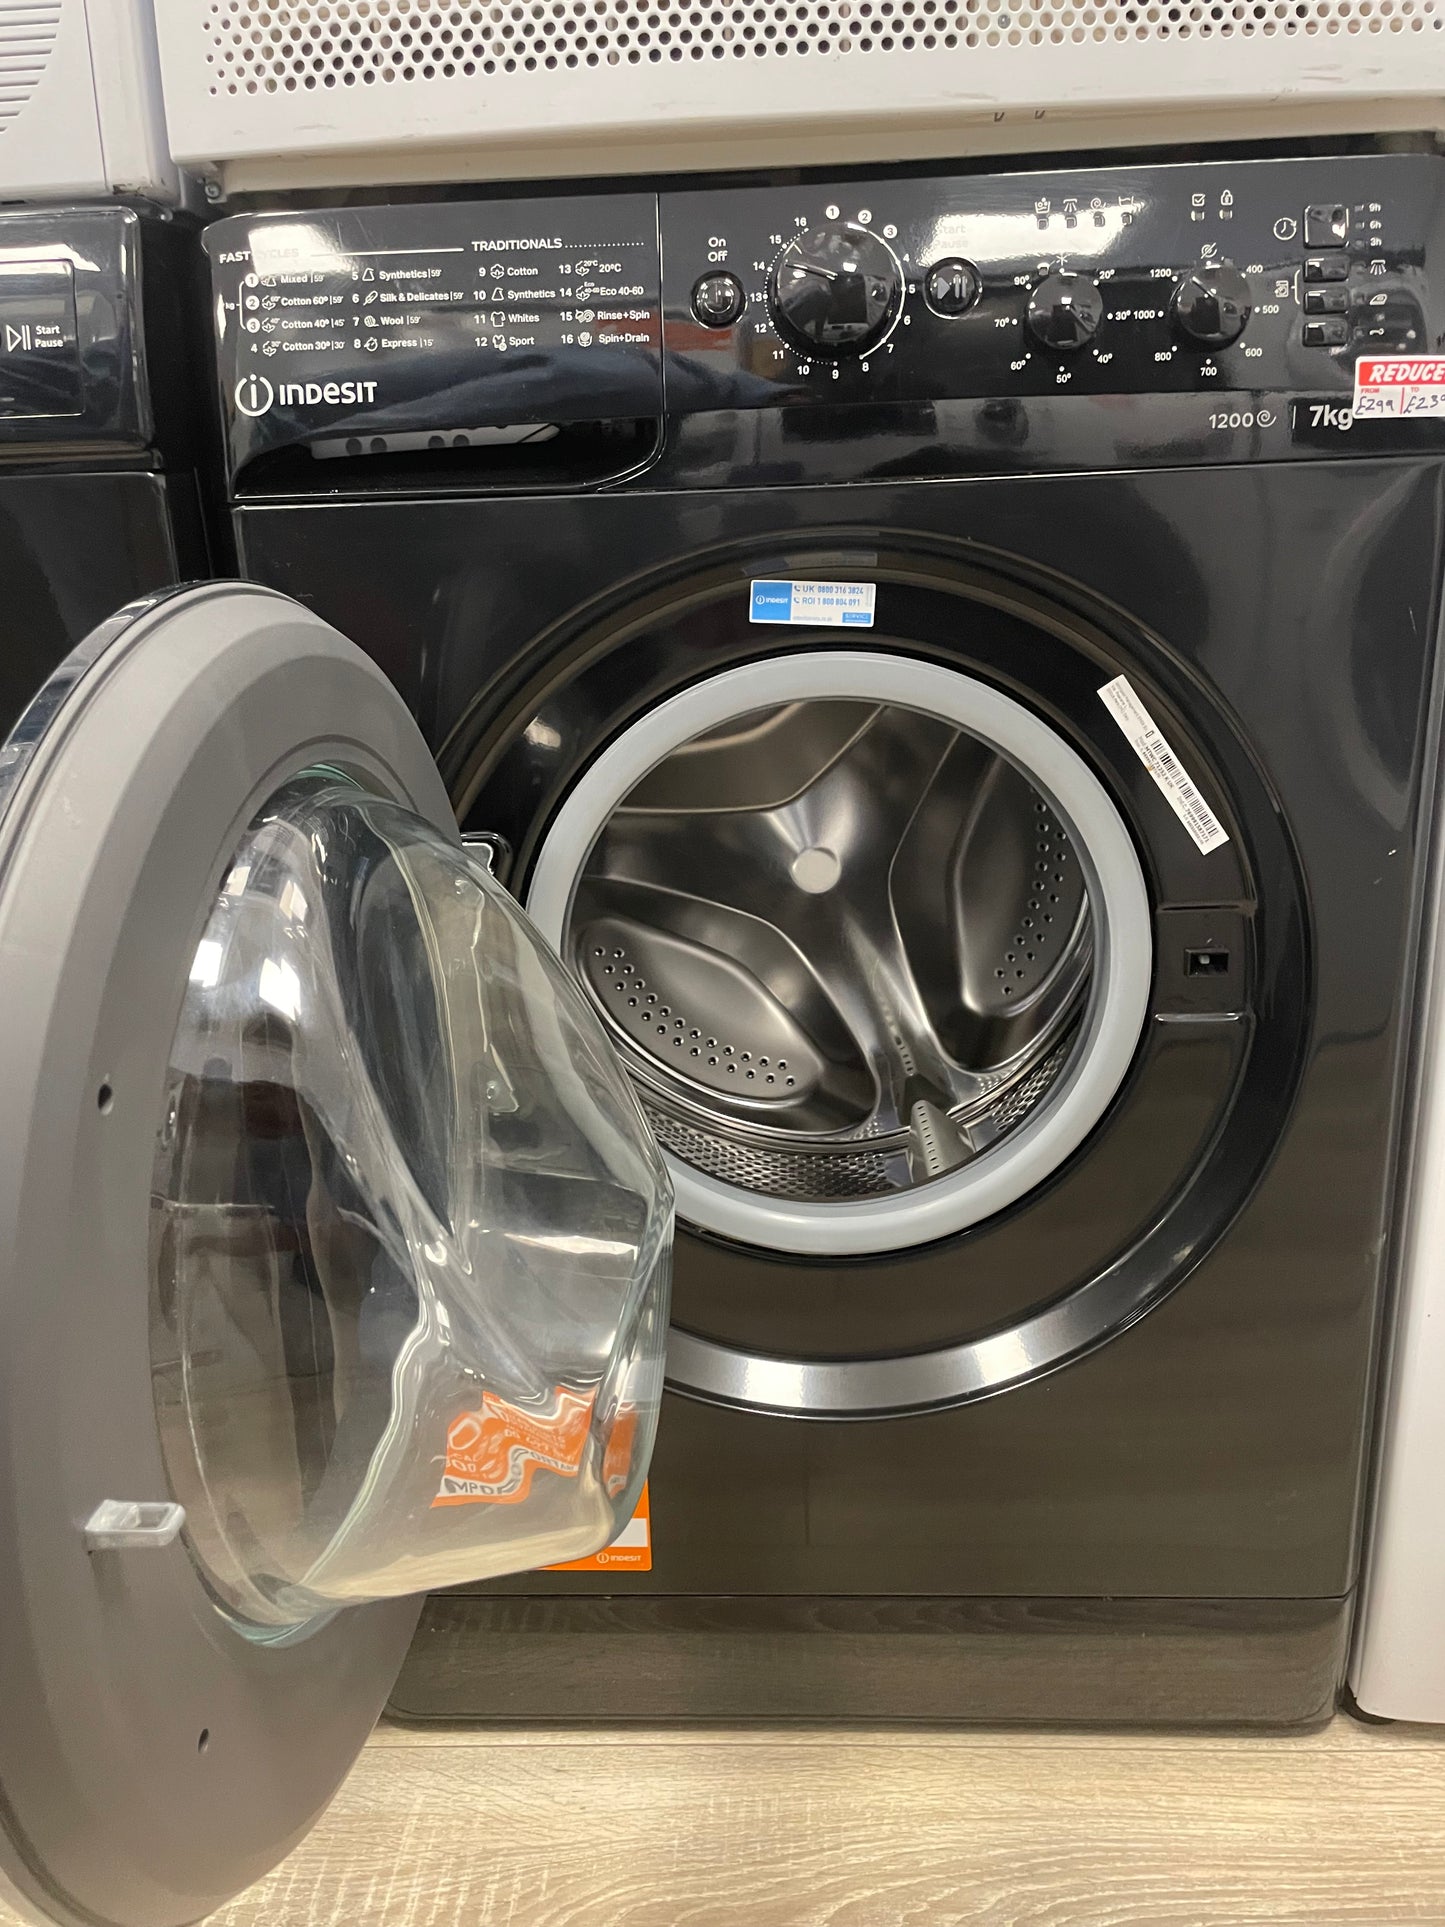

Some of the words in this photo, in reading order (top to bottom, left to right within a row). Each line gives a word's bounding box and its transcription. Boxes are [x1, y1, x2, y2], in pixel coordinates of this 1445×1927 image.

[1369, 203, 1381, 212] 9h
[794, 217, 806, 227] 16
[1370, 220, 1381, 229] 6h
[472, 238, 563, 251] TRADITIONALS
[708, 237, 726, 247] On
[769, 235, 782, 244] 15
[1370, 237, 1382, 246] 3h
[219, 251, 251, 263] FAST
[708, 251, 728, 262] Off
[903, 254, 910, 262] 4
[479, 267, 486, 276] 9
[507, 267, 538, 276] Cotton
[559, 265, 571, 274] 13
[753, 262, 765, 271] 14
[1246, 265, 1263, 274] 400
[352, 272, 358, 280] 5
[379, 269, 428, 281] Synthetics
[1150, 269, 1172, 278] 1200
[281, 275, 308, 283] Mixed
[559, 288, 572, 297] 14
[600, 287, 617, 296] Eco
[618, 286, 644, 295] 40-60
[908, 285, 915, 294] 5
[352, 294, 359, 303] 6
[380, 293, 397, 302] Silk
[398, 293, 406, 302] &
[406, 292, 450, 301] Delicates
[473, 290, 486, 300] 10
[507, 290, 556, 300] Synthetics
[750, 293, 762, 302] 13
[281, 297, 312, 306] Cotton
[1133, 310, 1155, 319] 1000
[1262, 305, 1279, 314] 500
[352, 317, 360, 326] 7
[380, 316, 404, 325] Wool
[474, 315, 486, 324] 11
[508, 314, 540, 323] Whites
[560, 312, 573, 322] 15
[597, 310, 650, 321] Rinse+Spin
[904, 316, 911, 326] 6
[281, 320, 313, 329] Cotton
[754, 323, 767, 333] 12
[35, 325, 60, 335] Start
[35, 338, 64, 348] Pause
[475, 337, 488, 347] 12
[509, 336, 535, 347] Sport
[561, 334, 573, 344] 16
[598, 333, 650, 344] Spin+Drain
[251, 344, 258, 353] 4
[282, 342, 314, 351] Cotton
[353, 339, 361, 348] 8
[381, 339, 418, 349] Express
[887, 344, 894, 353] 7
[772, 350, 784, 360] 11
[1155, 352, 1171, 361] 800
[1245, 348, 1262, 357] 600
[797, 365, 810, 375] 10
[862, 362, 869, 372] 8
[1200, 367, 1217, 377] 700
[832, 370, 839, 379] 9
[1368, 363, 1445, 383] REDUCE
[1354, 396, 1394, 415] £299
[1209, 413, 1254, 429] 1200
[1309, 405, 1353, 430] 7kg
[802, 585, 815, 593] UK
[817, 585, 833, 594] 0800
[834, 586, 847, 594] 316
[848, 586, 864, 595] 3824
[822, 598, 835, 606] 800
[835, 598, 848, 606] 804
[848, 599, 860, 607] 091
